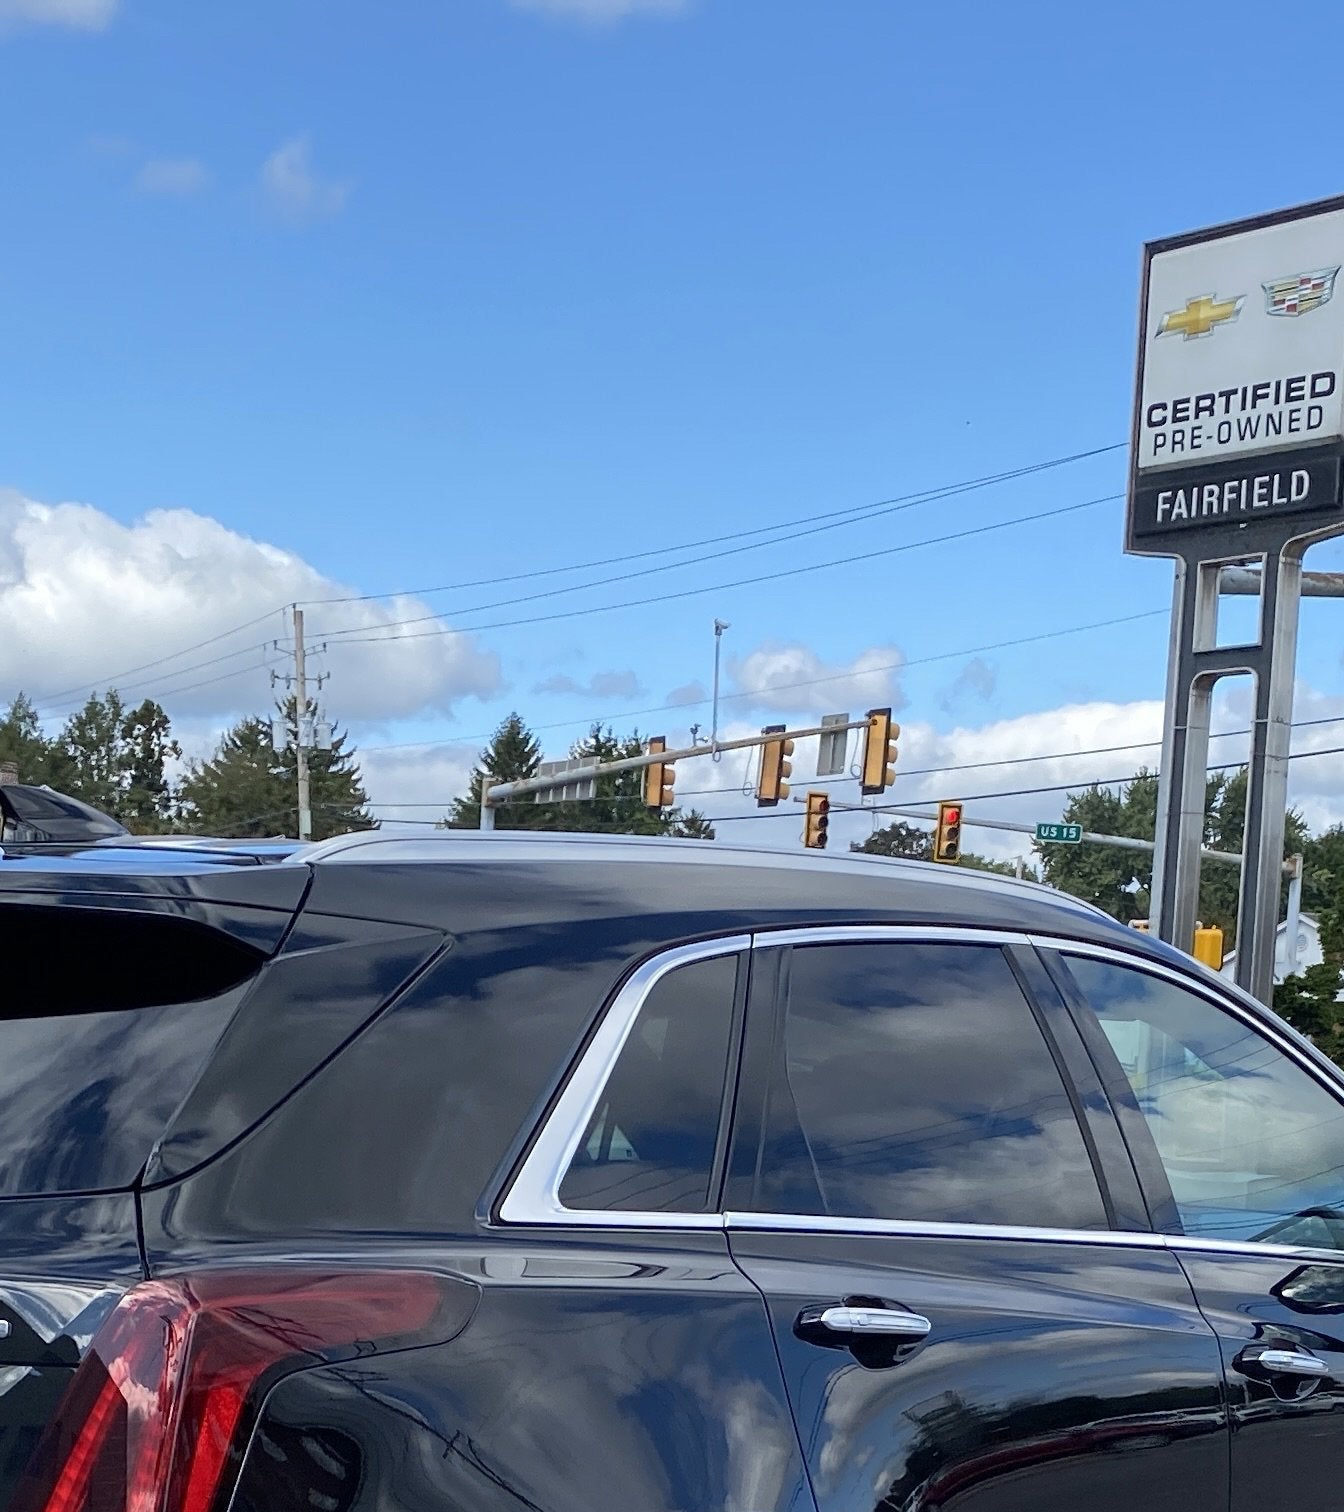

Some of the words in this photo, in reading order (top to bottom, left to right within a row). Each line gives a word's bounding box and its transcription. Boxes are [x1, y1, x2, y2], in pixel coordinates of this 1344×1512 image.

[1146, 371, 1336, 429] CERTIFIED
[1153, 405, 1323, 456] PRE-OWNED
[1156, 469, 1311, 523] FAIRFIELD
[1040, 826, 1057, 837] US
[1062, 827, 1076, 838] 15
